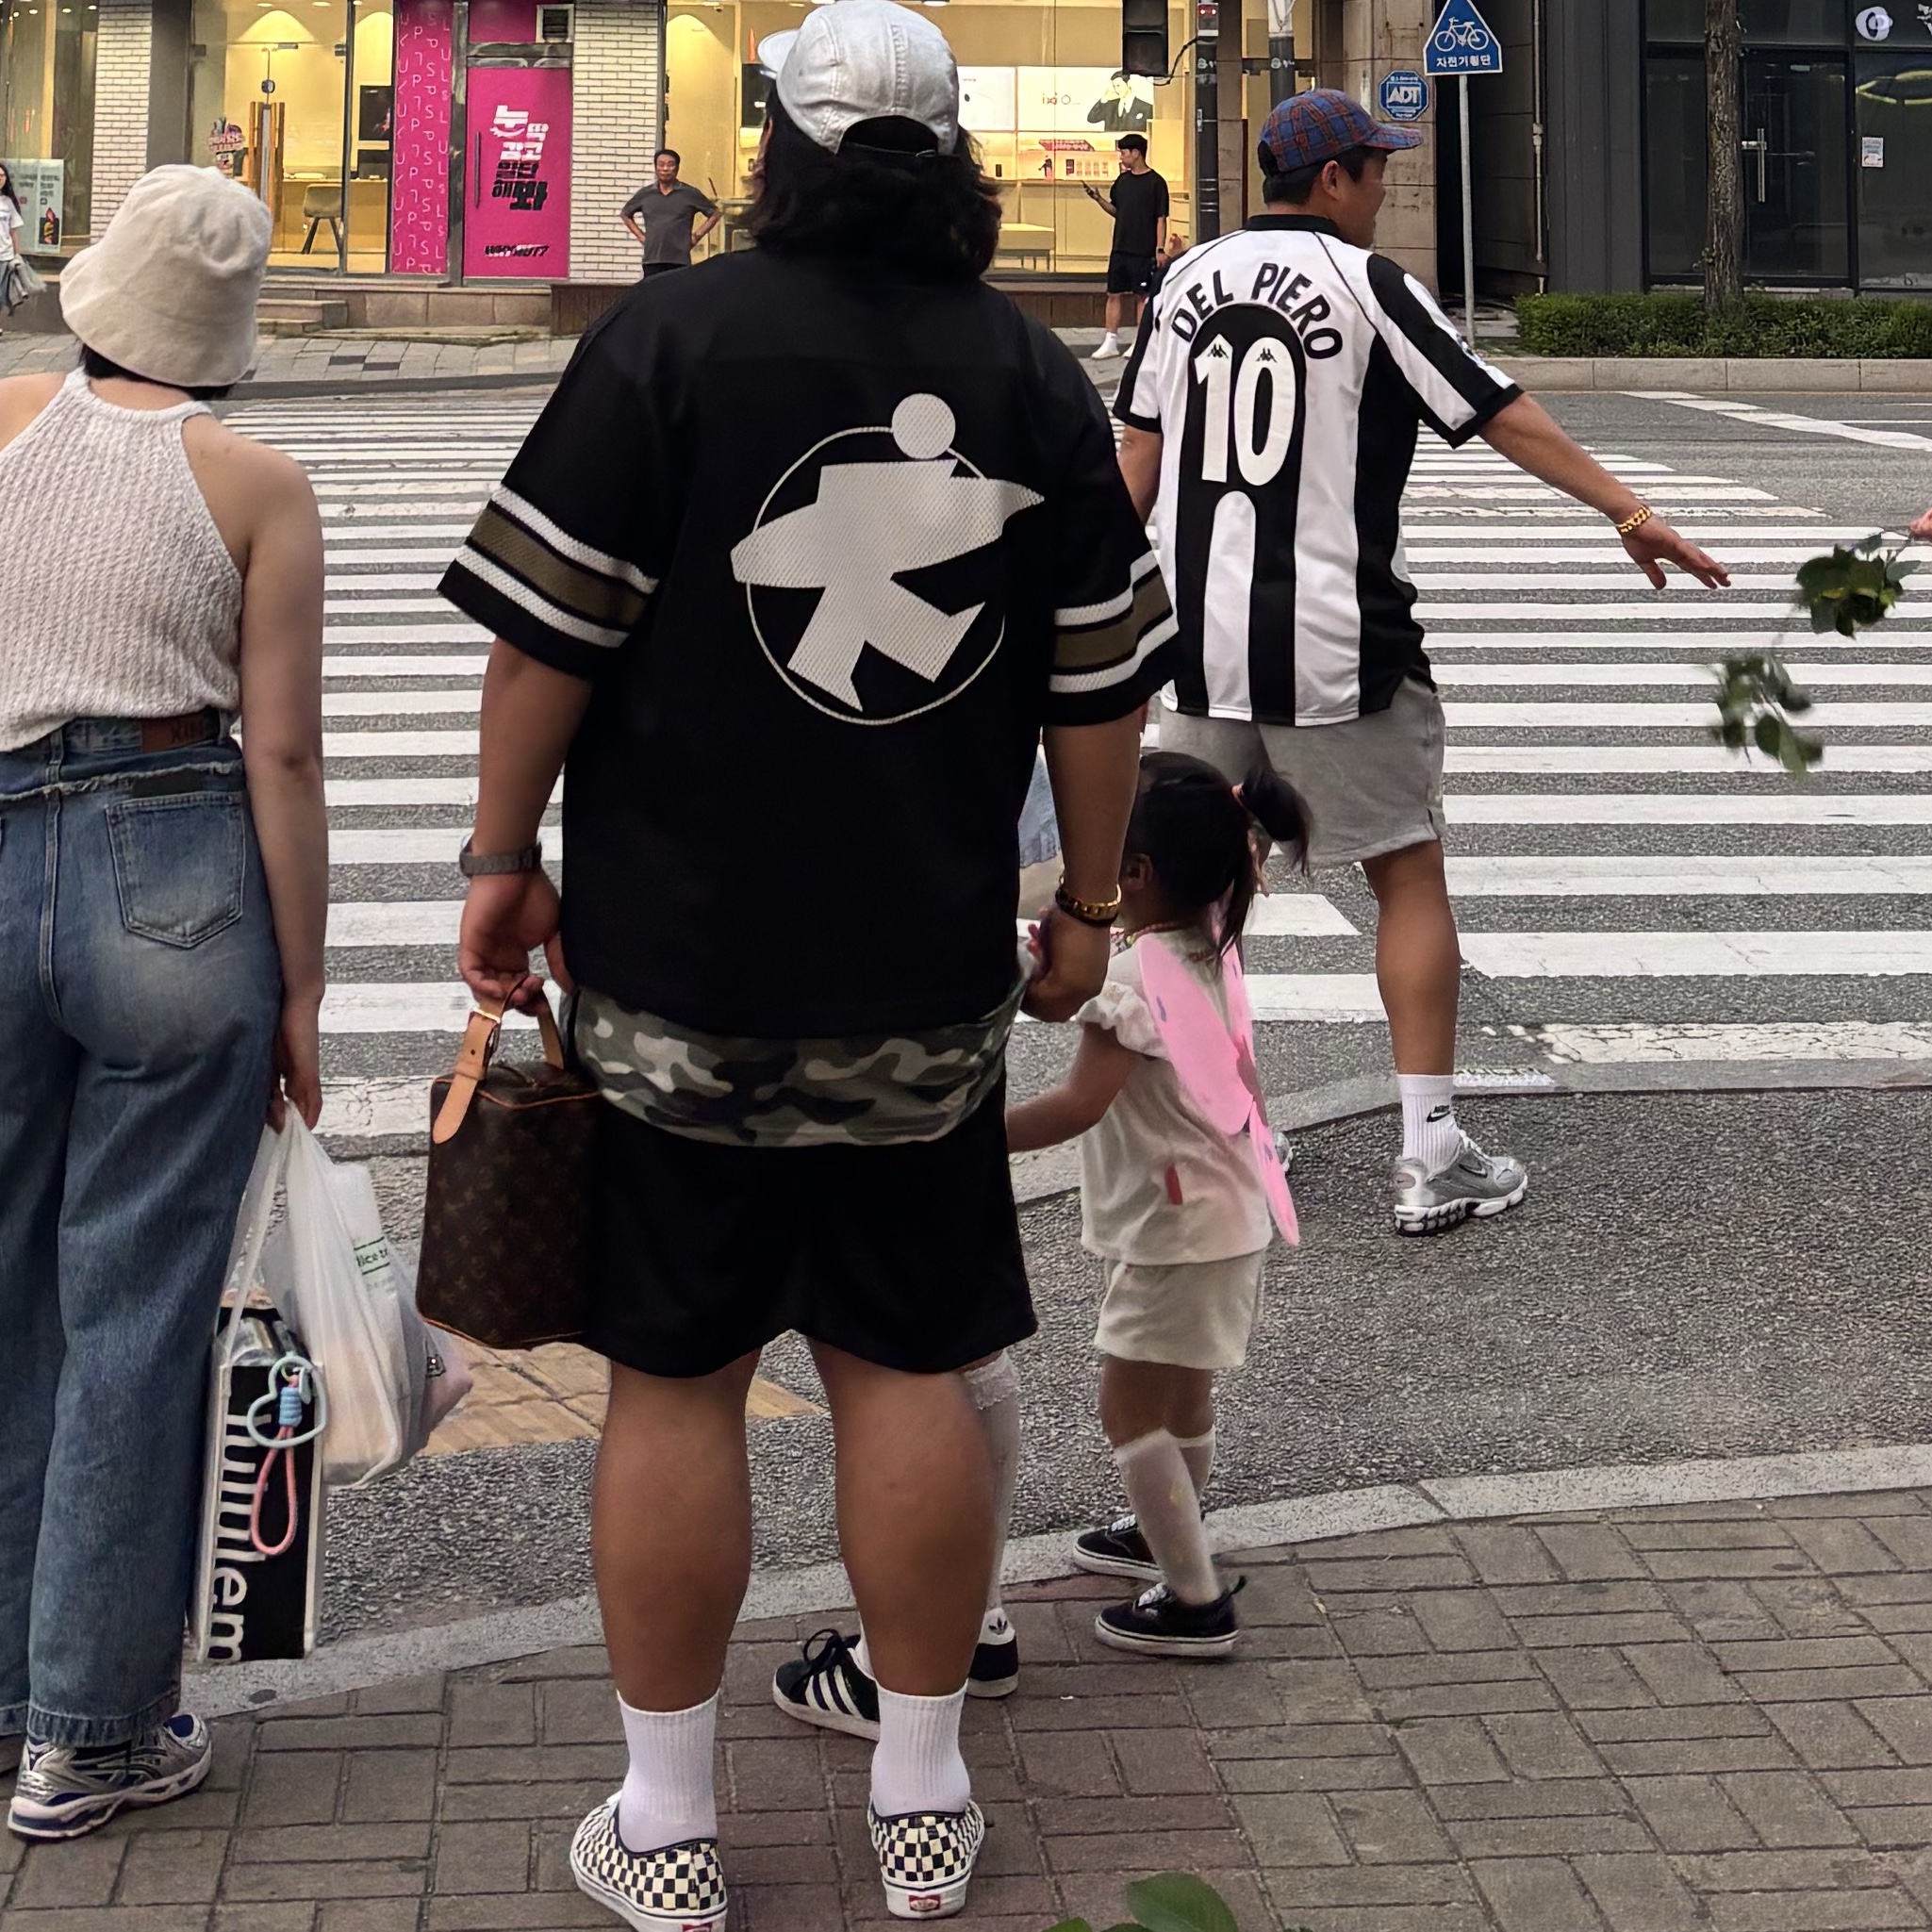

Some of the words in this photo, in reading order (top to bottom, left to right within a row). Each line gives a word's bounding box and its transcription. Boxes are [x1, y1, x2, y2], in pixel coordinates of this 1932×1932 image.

[1387, 87, 1420, 104] ADT
[1171, 270, 1234, 342] DEL
[1251, 262, 1343, 359] PIERO
[1194, 334, 1296, 487] 10
